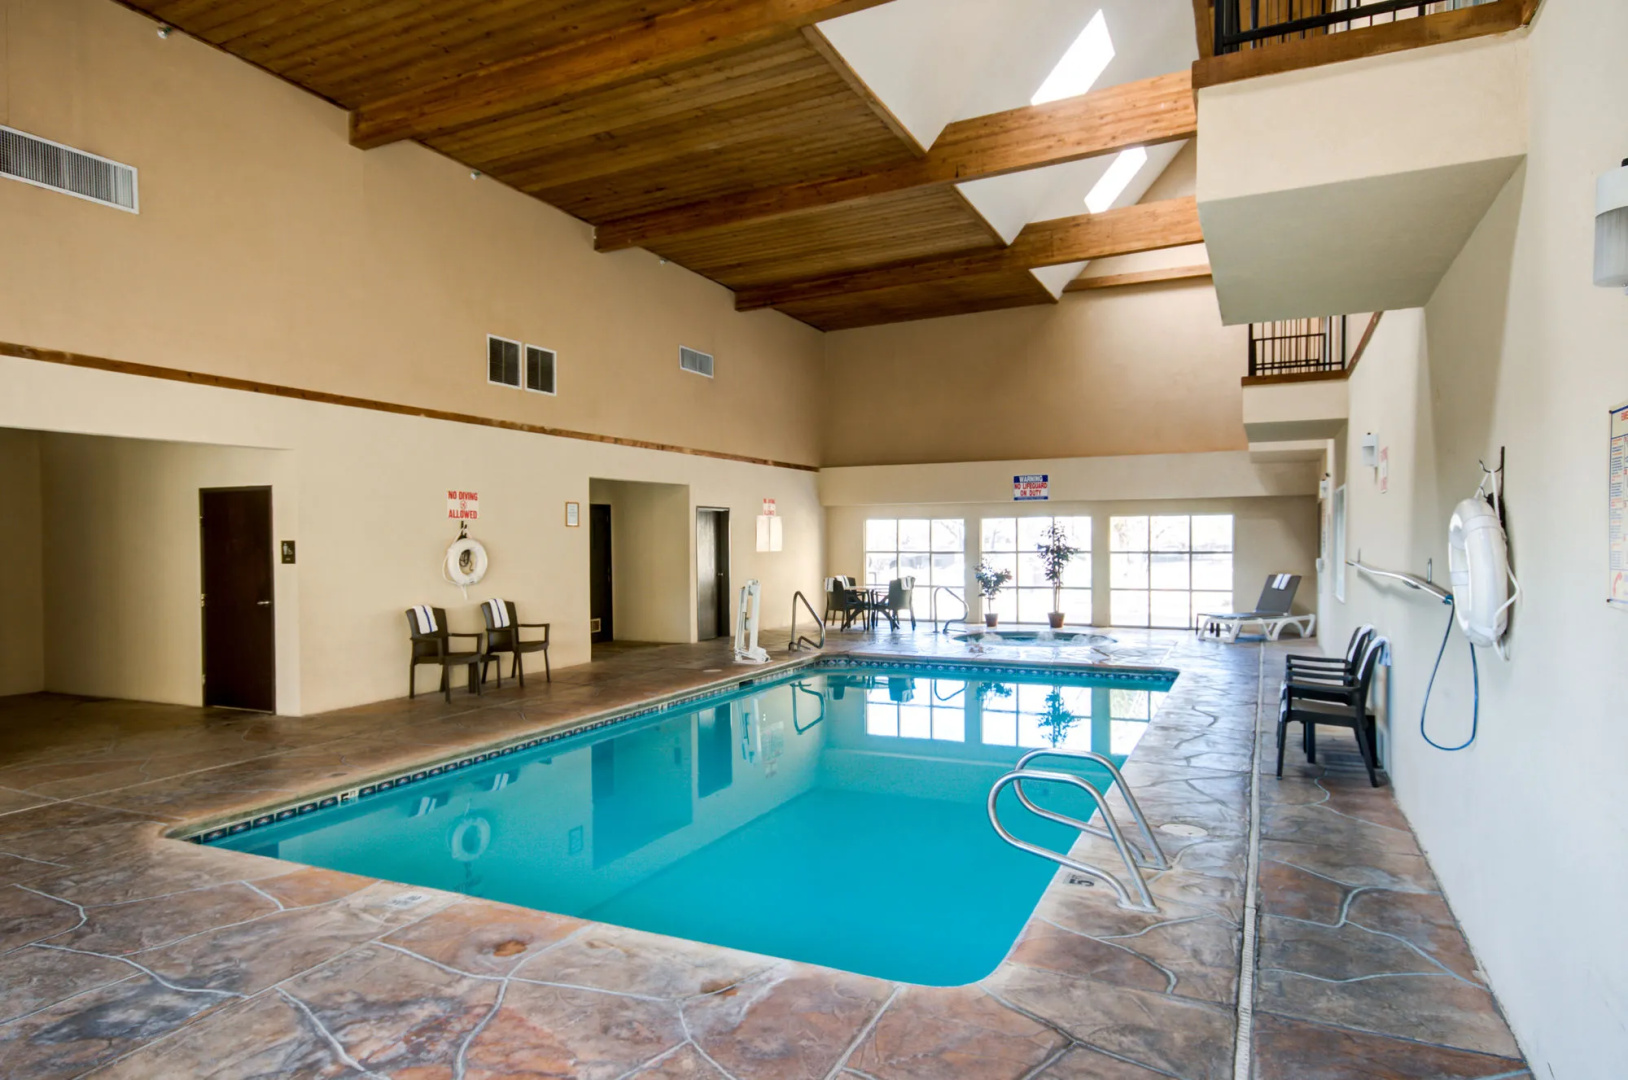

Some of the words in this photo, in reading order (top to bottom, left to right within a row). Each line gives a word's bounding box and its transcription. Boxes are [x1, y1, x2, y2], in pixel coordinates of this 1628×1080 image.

[1019, 475, 1043, 483] WARNING
[448, 490, 457, 499] NO
[459, 491, 478, 501] DIVING
[448, 509, 477, 519] ALLOWED
